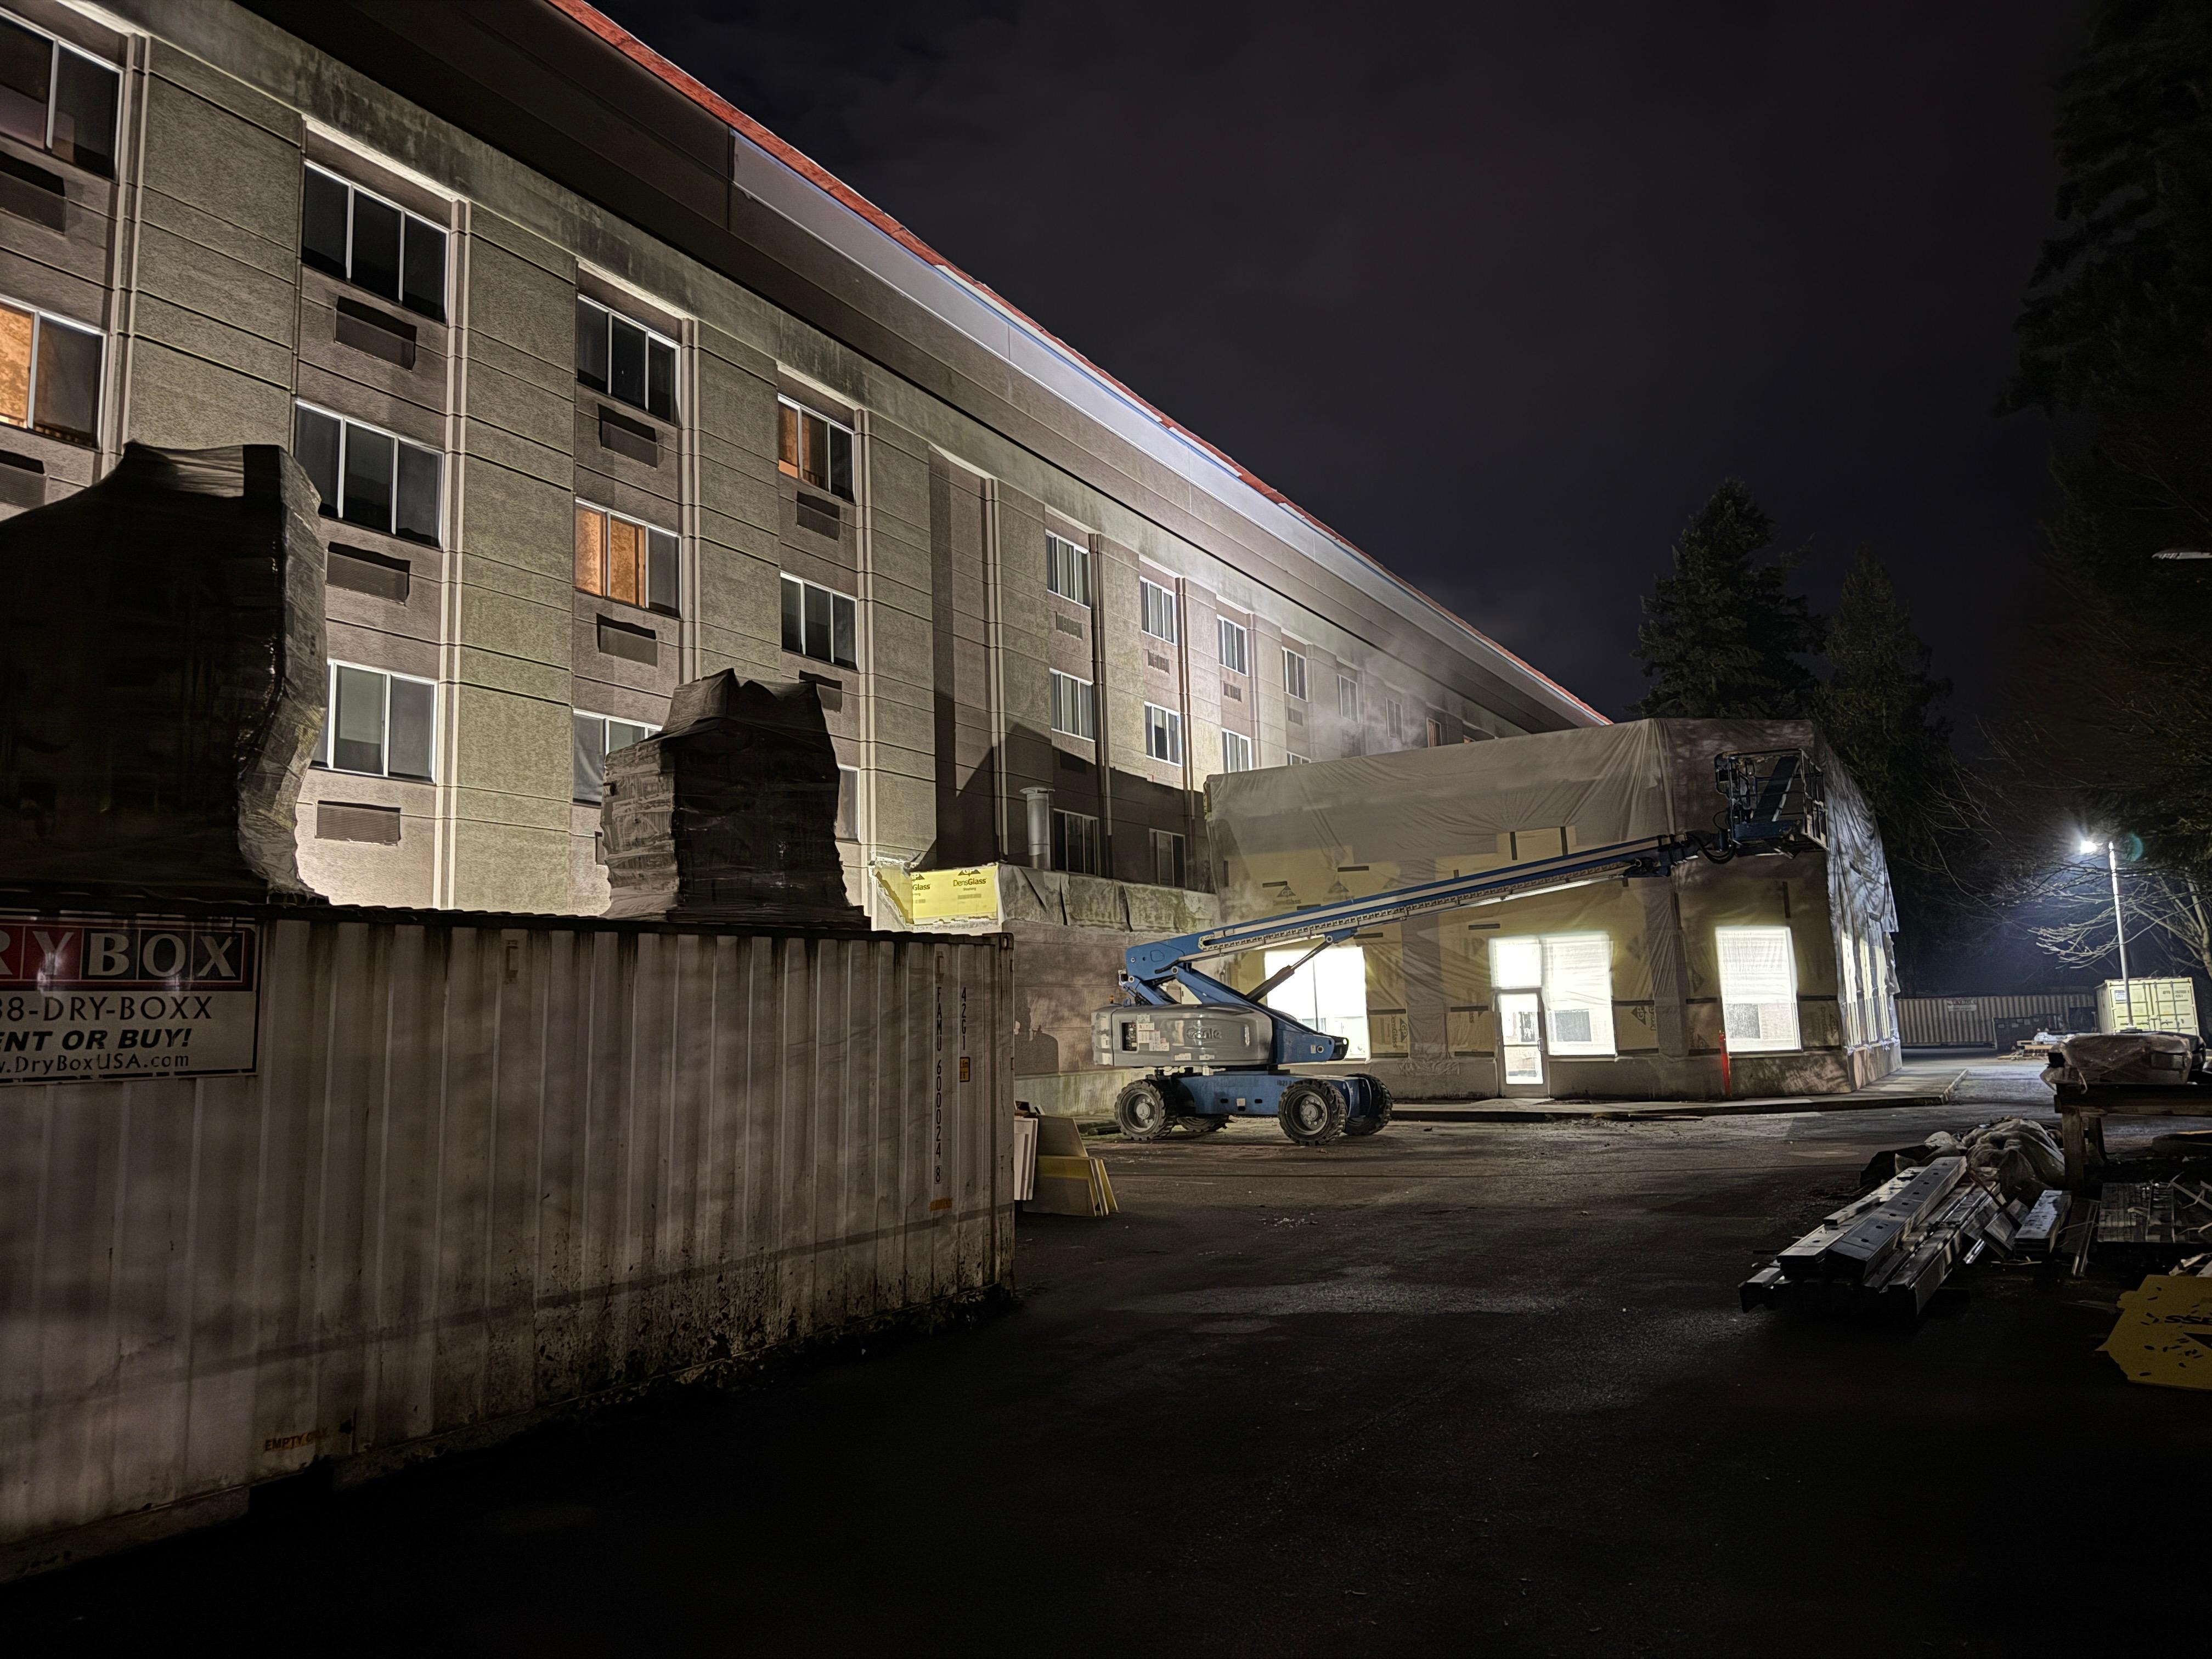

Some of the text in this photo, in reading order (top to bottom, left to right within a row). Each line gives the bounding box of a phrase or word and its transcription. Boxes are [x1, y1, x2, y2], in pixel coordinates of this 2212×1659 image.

[953, 878, 986, 887] DensGlass
[0, 996, 212, 1022] 8-DRY-BOXX
[0, 1028, 191, 1052] NT OR BUY!
[936, 1167, 940, 1183] 8
[265, 1435, 303, 1451] EMPTY
